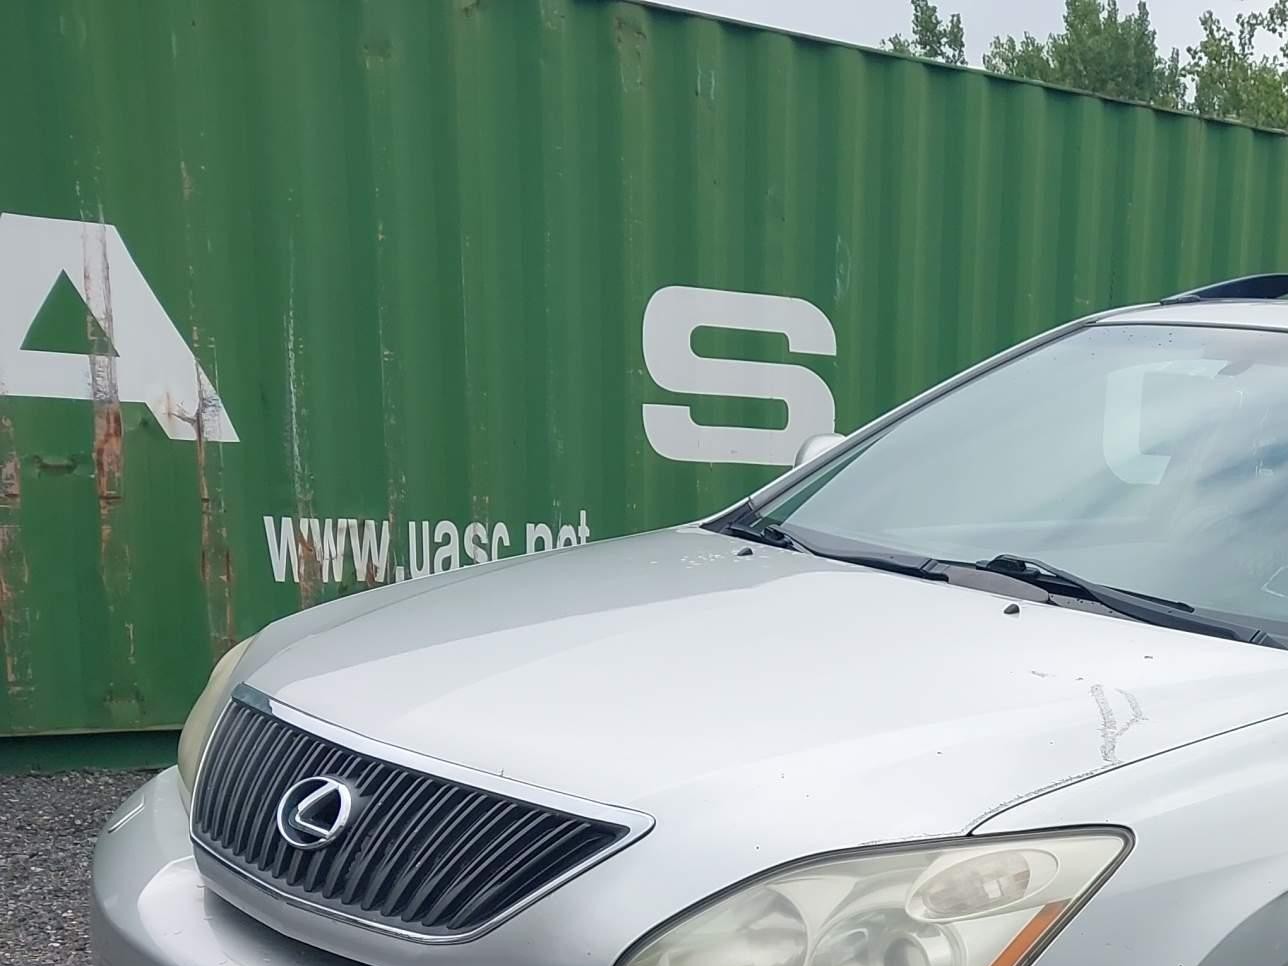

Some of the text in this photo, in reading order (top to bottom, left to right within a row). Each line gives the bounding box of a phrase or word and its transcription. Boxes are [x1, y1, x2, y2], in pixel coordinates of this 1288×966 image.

[0, 212, 239, 442] A
[643, 286, 837, 465] S
[263, 510, 591, 583] www.uascnt
